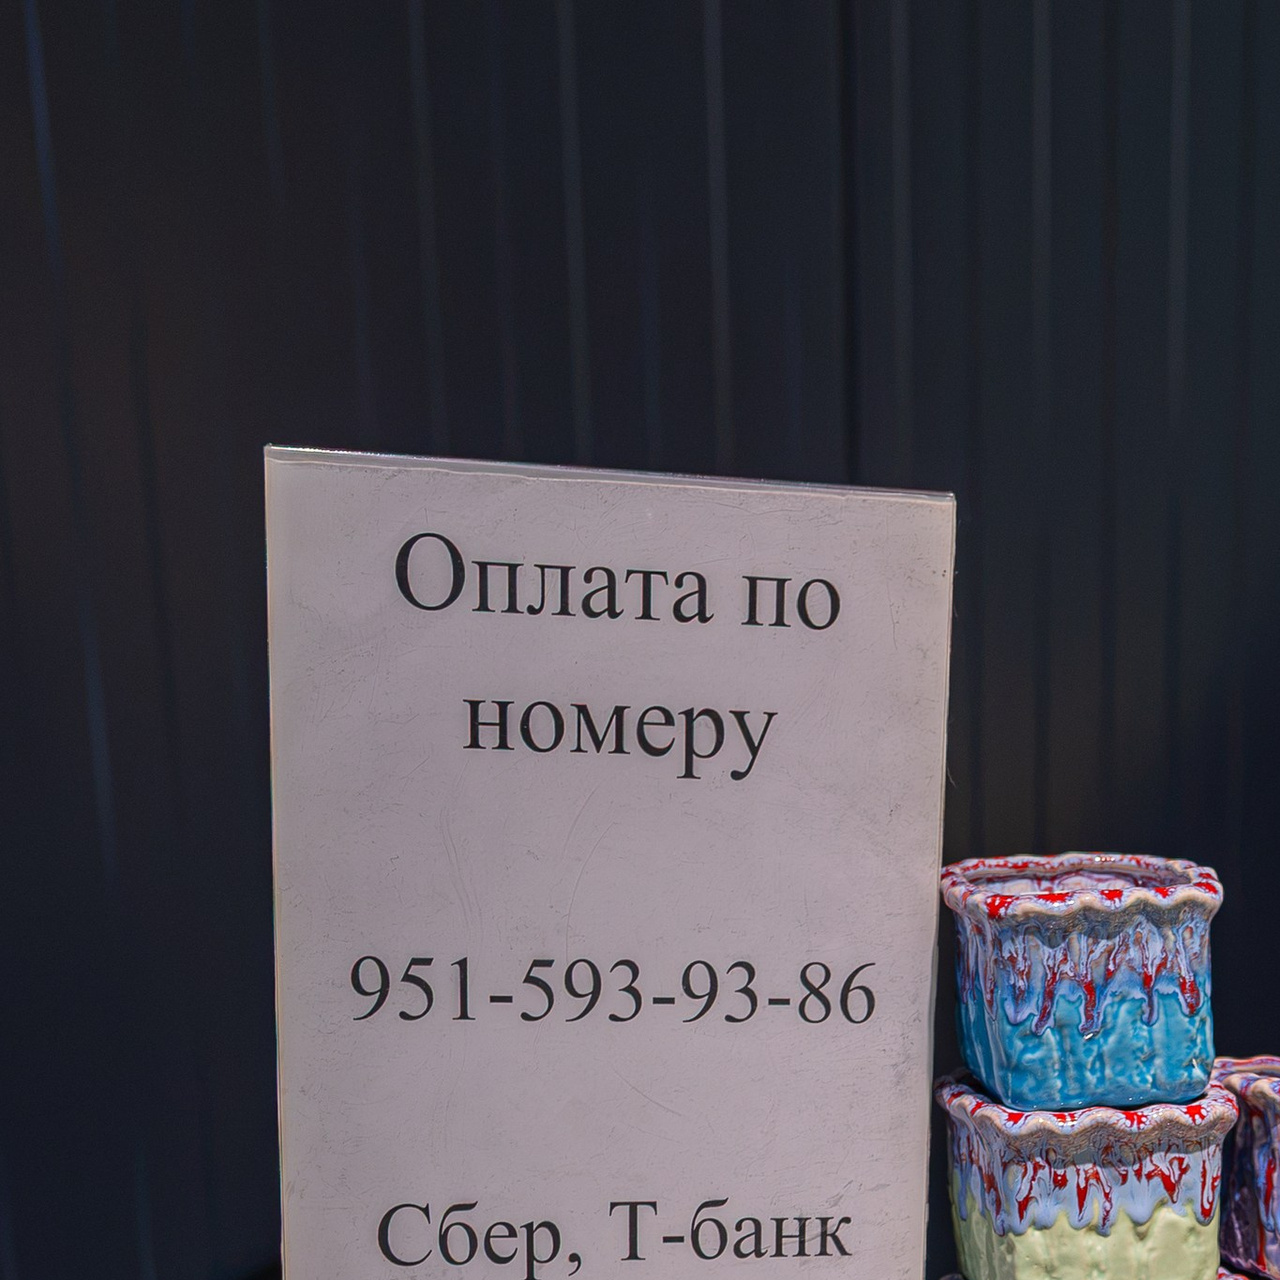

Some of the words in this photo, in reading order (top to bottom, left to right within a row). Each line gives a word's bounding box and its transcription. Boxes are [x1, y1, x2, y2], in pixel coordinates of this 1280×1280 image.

[395, 532, 715, 624] Оплата
[741, 575, 841, 631] по
[462, 697, 779, 781] номеру
[350, 955, 876, 1024] 951-593-93-86
[609, 1197, 853, 1261] Т-банк
